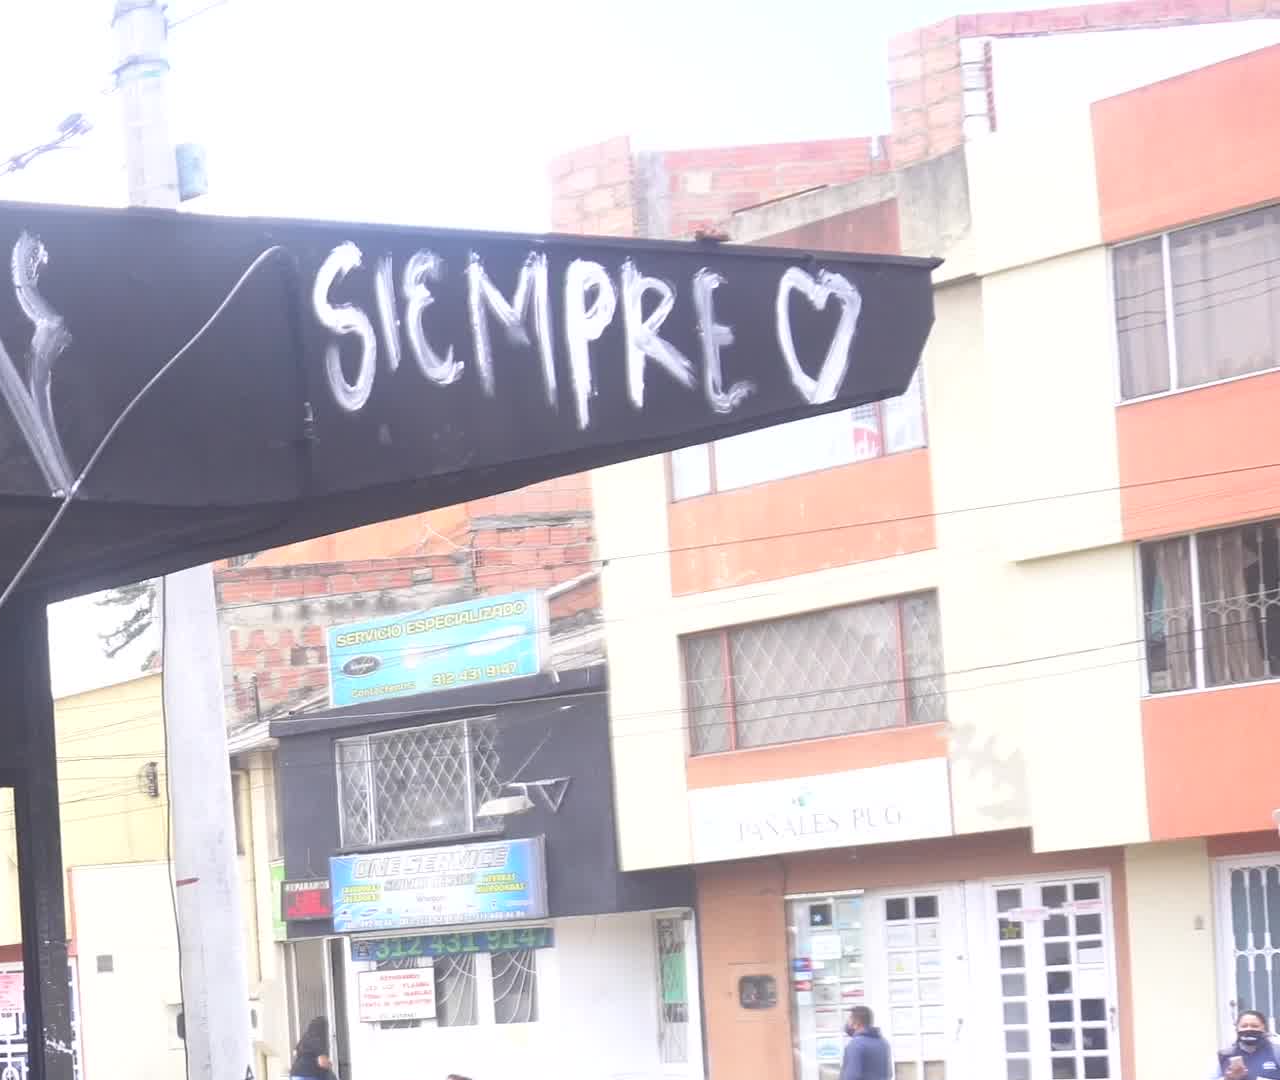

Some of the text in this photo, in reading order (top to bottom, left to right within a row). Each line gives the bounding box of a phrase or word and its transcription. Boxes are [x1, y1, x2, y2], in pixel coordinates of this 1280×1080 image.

[313, 241, 758, 430] SIEMPRE
[336, 602, 527, 648] SERVICIO ESPECIALIZADO
